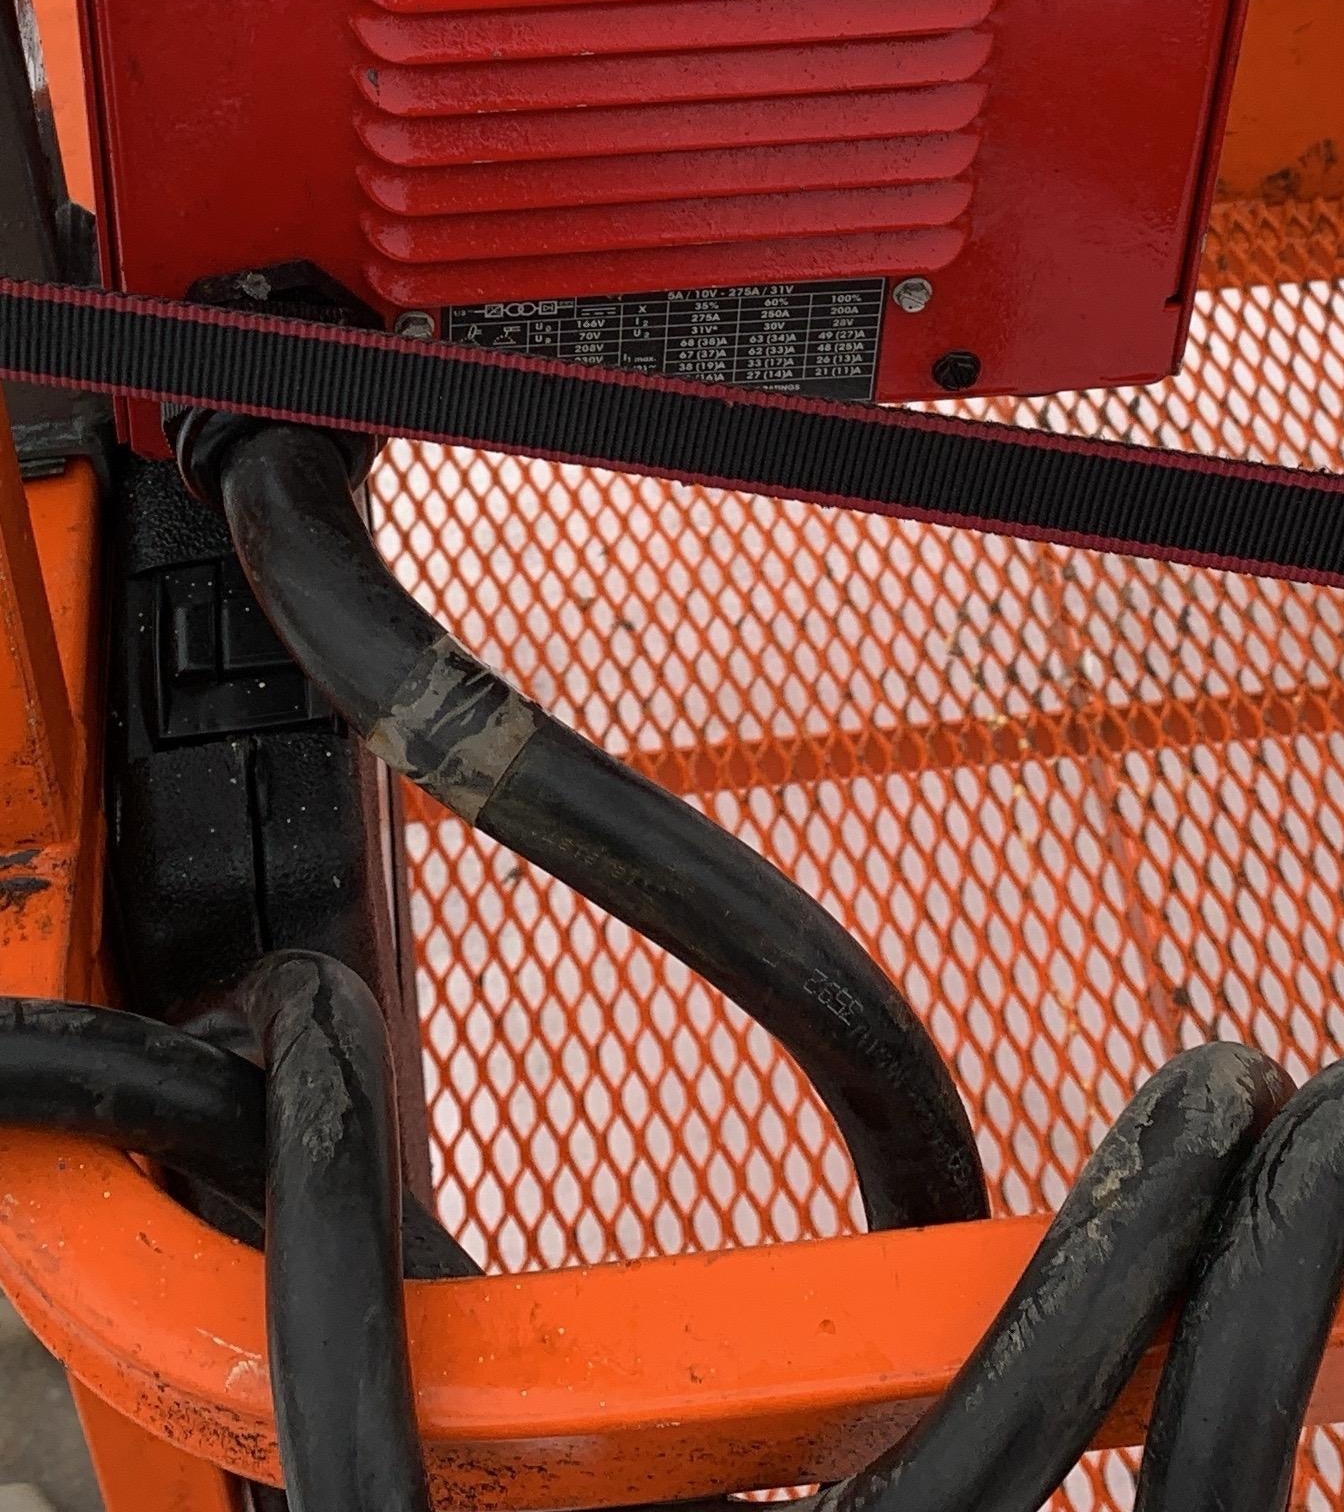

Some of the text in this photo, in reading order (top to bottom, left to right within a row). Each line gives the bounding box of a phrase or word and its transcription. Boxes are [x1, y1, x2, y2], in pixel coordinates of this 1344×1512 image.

[695, 289, 717, 299] 10V
[728, 287, 760, 297] 275A
[770, 285, 794, 295] 31V
[763, 298, 789, 307] 60%
[831, 294, 862, 303] 100%
[694, 301, 719, 310] 35%
[760, 309, 790, 319] 250A
[830, 306, 859, 315] 200A
[690, 313, 721, 323] 275A
[832, 318, 855, 327] 28V
[576, 319, 606, 328] 166V
[763, 322, 786, 331] 30V
[578, 331, 602, 341] 70V
[574, 343, 604, 353] 208V
